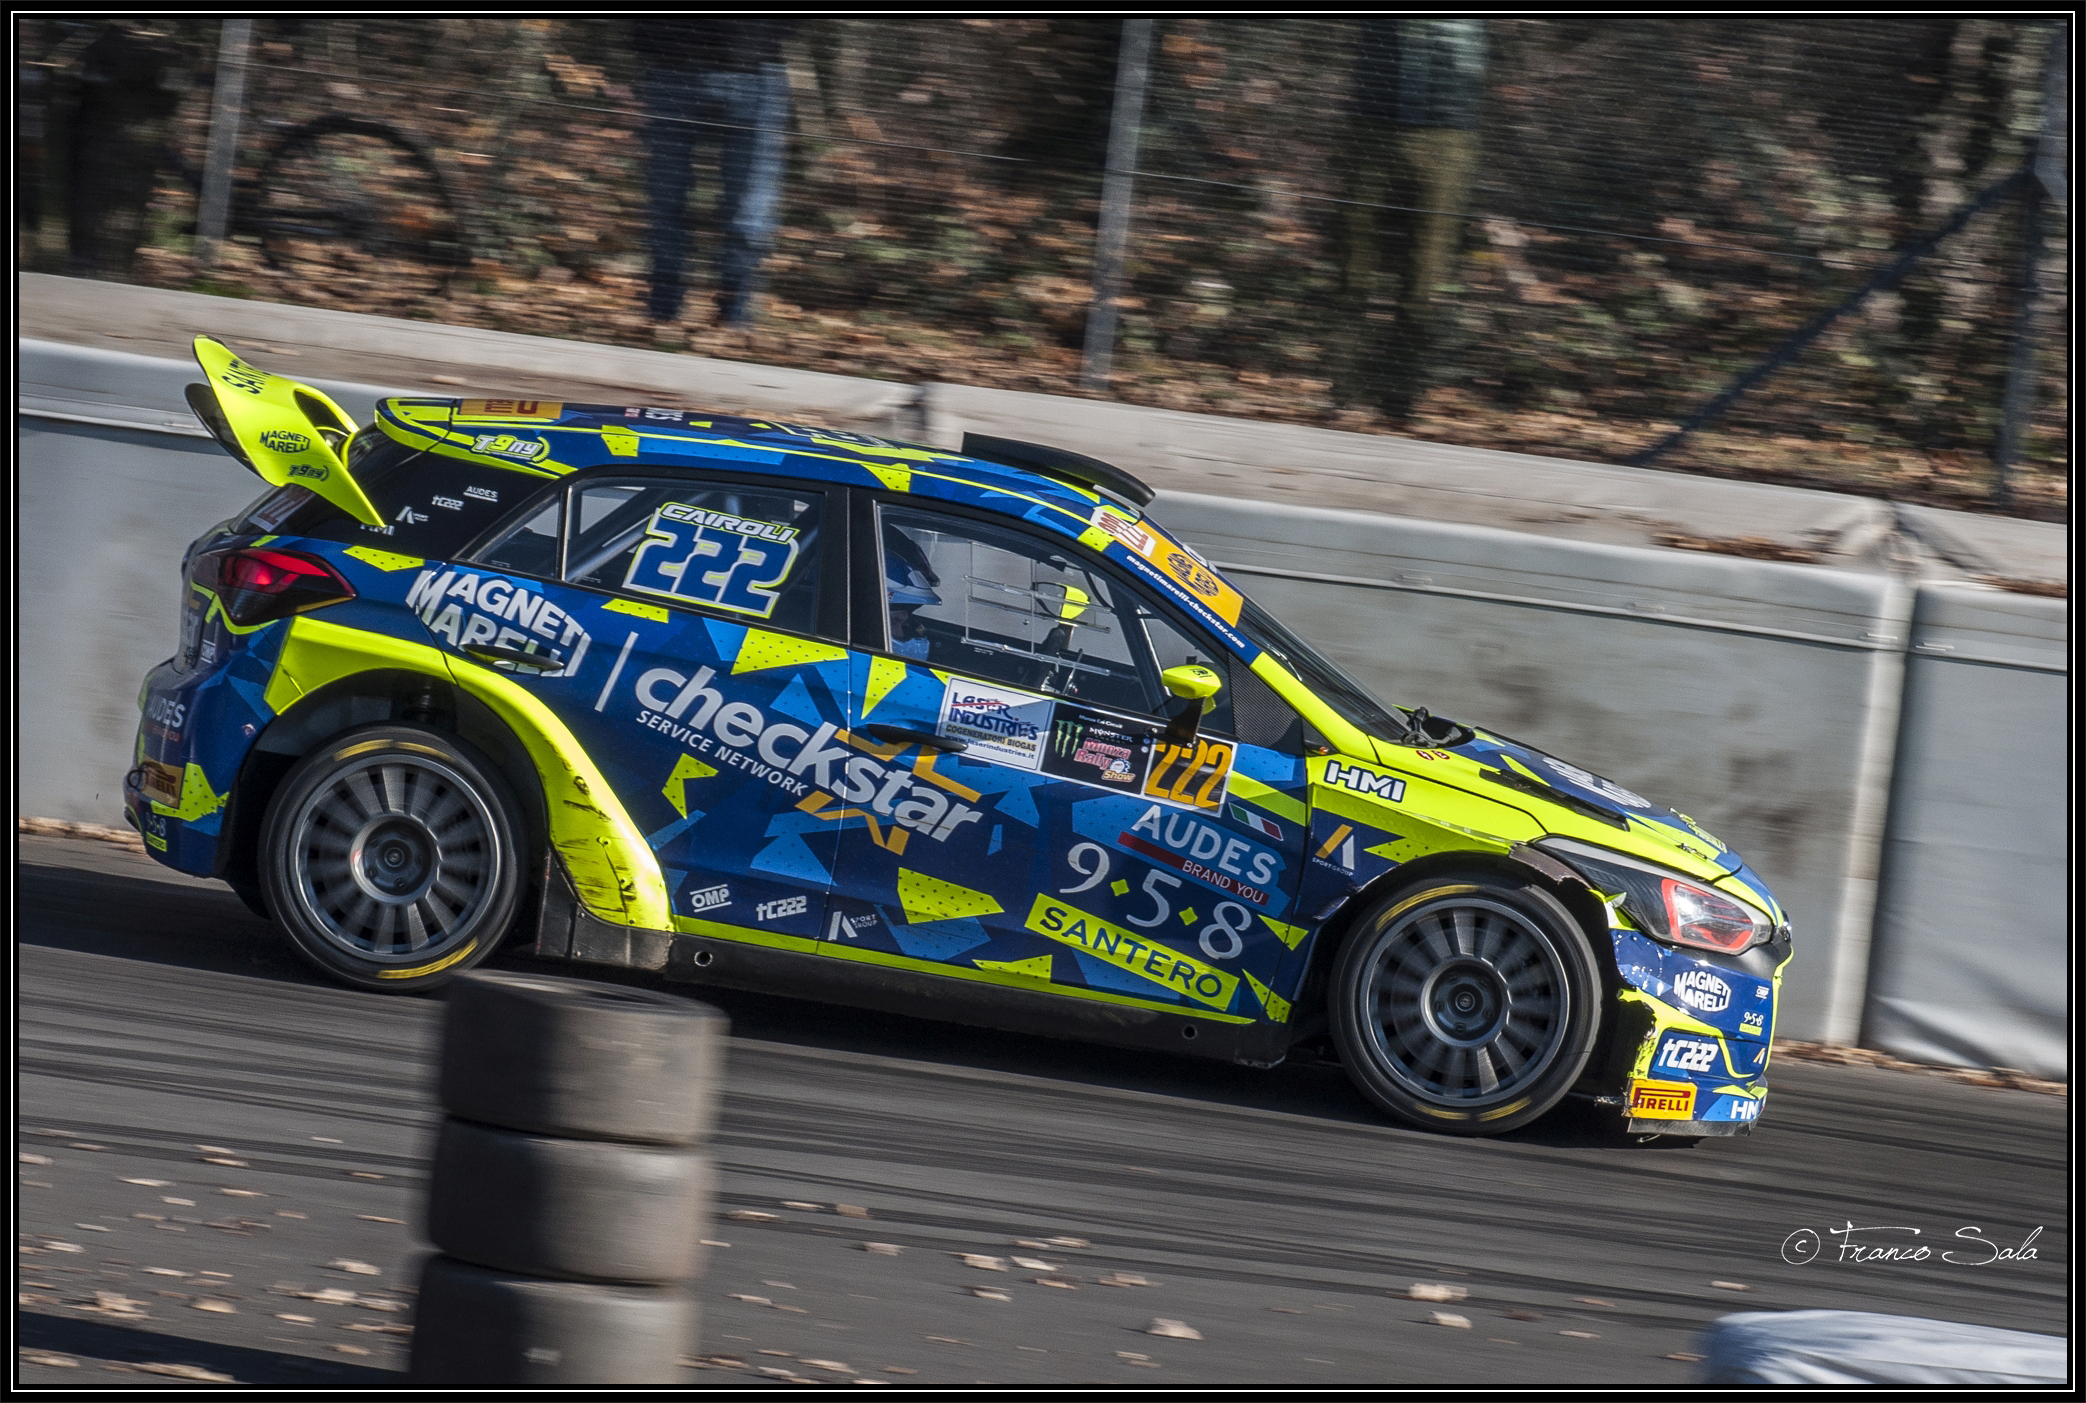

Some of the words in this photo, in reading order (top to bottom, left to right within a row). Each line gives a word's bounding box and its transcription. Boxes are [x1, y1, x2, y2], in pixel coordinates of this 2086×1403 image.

[466, 485, 499, 499] AUDES
[660, 503, 794, 543] CAIROLI
[622, 514, 799, 619] 222
[1126, 554, 1246, 650] magnetimarelli-checkstar.com
[635, 665, 983, 843] checkstar
[636, 710, 713, 752] SERVICE
[714, 745, 808, 797] NETWORK
[946, 724, 1006, 746] COGENERATORI
[1007, 738, 1037, 752] BIOGAS
[1074, 748, 1113, 770] Rally
[1083, 737, 1131, 759] Monza
[1102, 770, 1135, 782] Show
[1145, 739, 1232, 811] 222
[1324, 760, 1406, 803] HMI
[1131, 804, 1277, 885] AUDES
[691, 887, 731, 908] OMP
[1183, 860, 1231, 890] BRAND
[1237, 881, 1266, 904] YOU
[1040, 906, 1222, 998] SANTERO
[1633, 1087, 1691, 1111] PIRELLI
